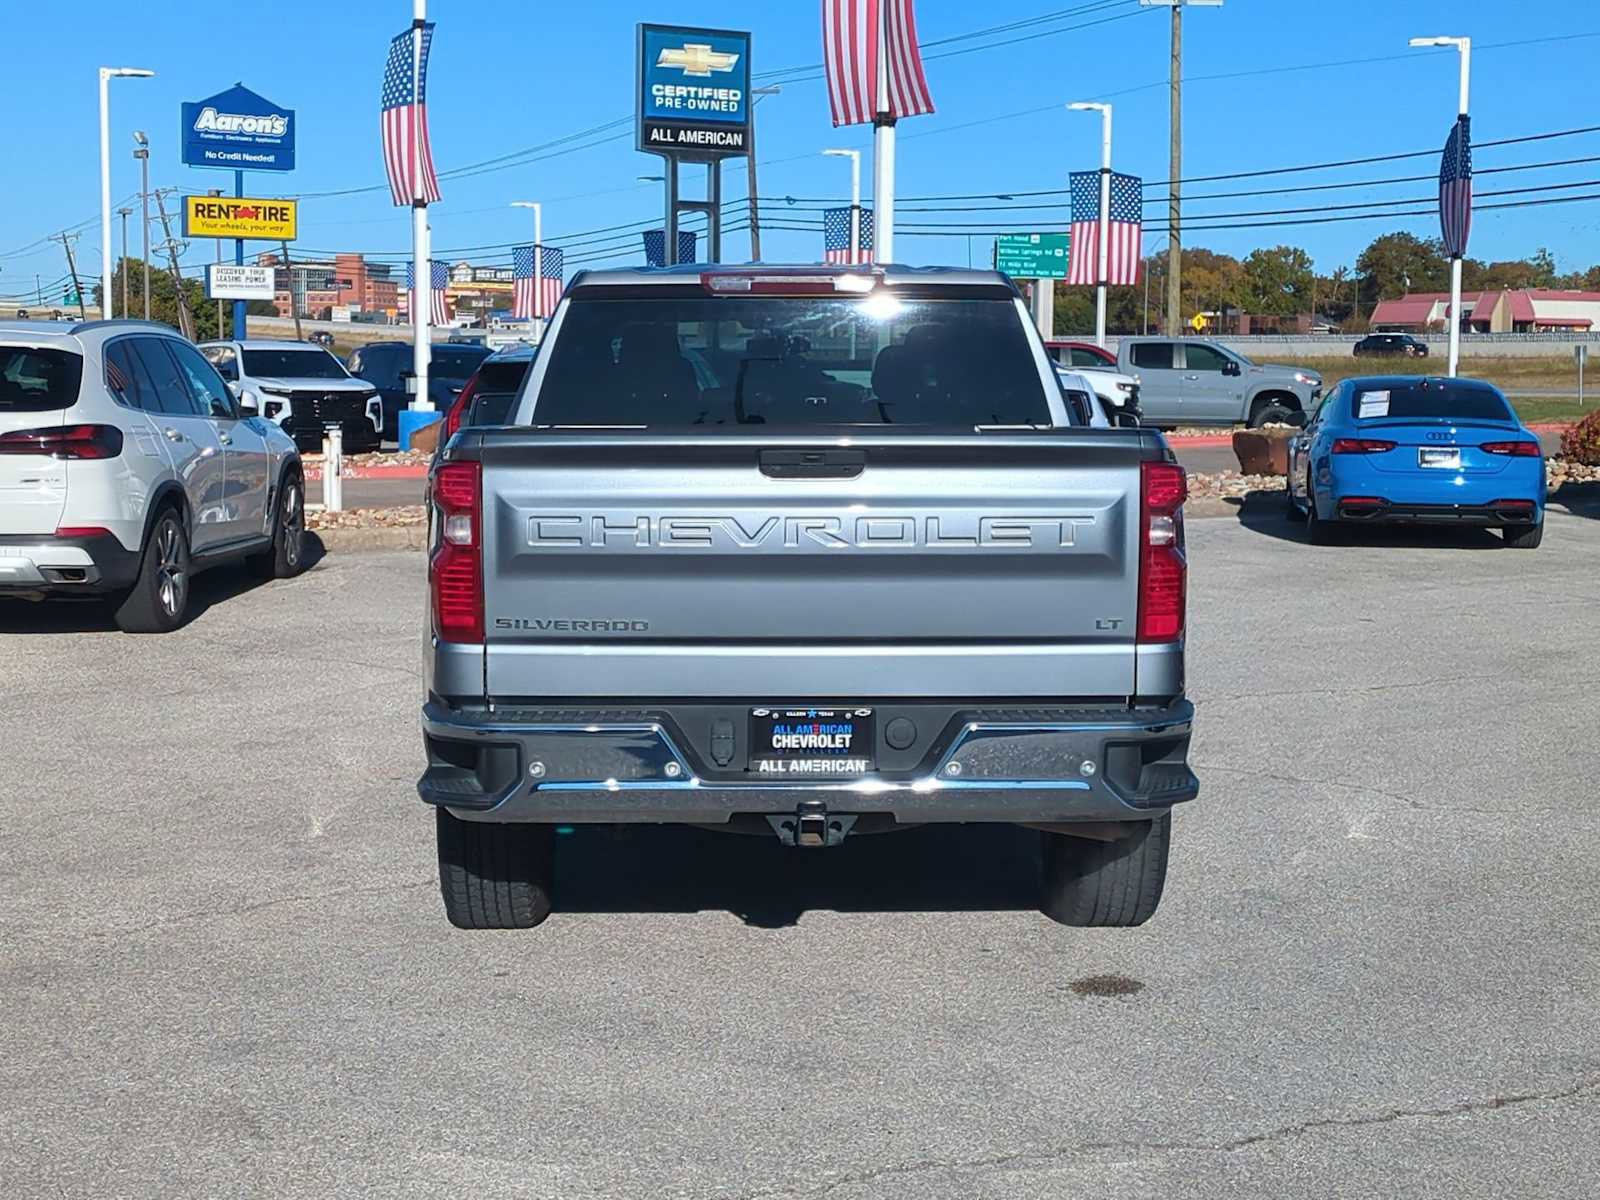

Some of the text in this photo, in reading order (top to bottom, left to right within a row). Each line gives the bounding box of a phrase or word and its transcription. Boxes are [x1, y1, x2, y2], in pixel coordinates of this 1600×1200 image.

[651, 84, 742, 101] CERTIFIED
[655, 97, 738, 112] PRE-OWNED
[193, 106, 289, 137] Aaron's
[650, 128, 743, 146] ALL AMERICAN
[205, 150, 217, 159] No
[217, 151, 241, 162] Credit
[200, 220, 219, 229] Your
[250, 225, 268, 233] your
[526, 515, 1098, 549] CHEVROLET
[495, 618, 649, 632] SILVERADO
[1095, 619, 1124, 630] LT
[773, 723, 853, 735] ALL AMERICAN
[771, 734, 853, 749] CHEVROLET
[759, 759, 867, 772] ALL AMERICAN
